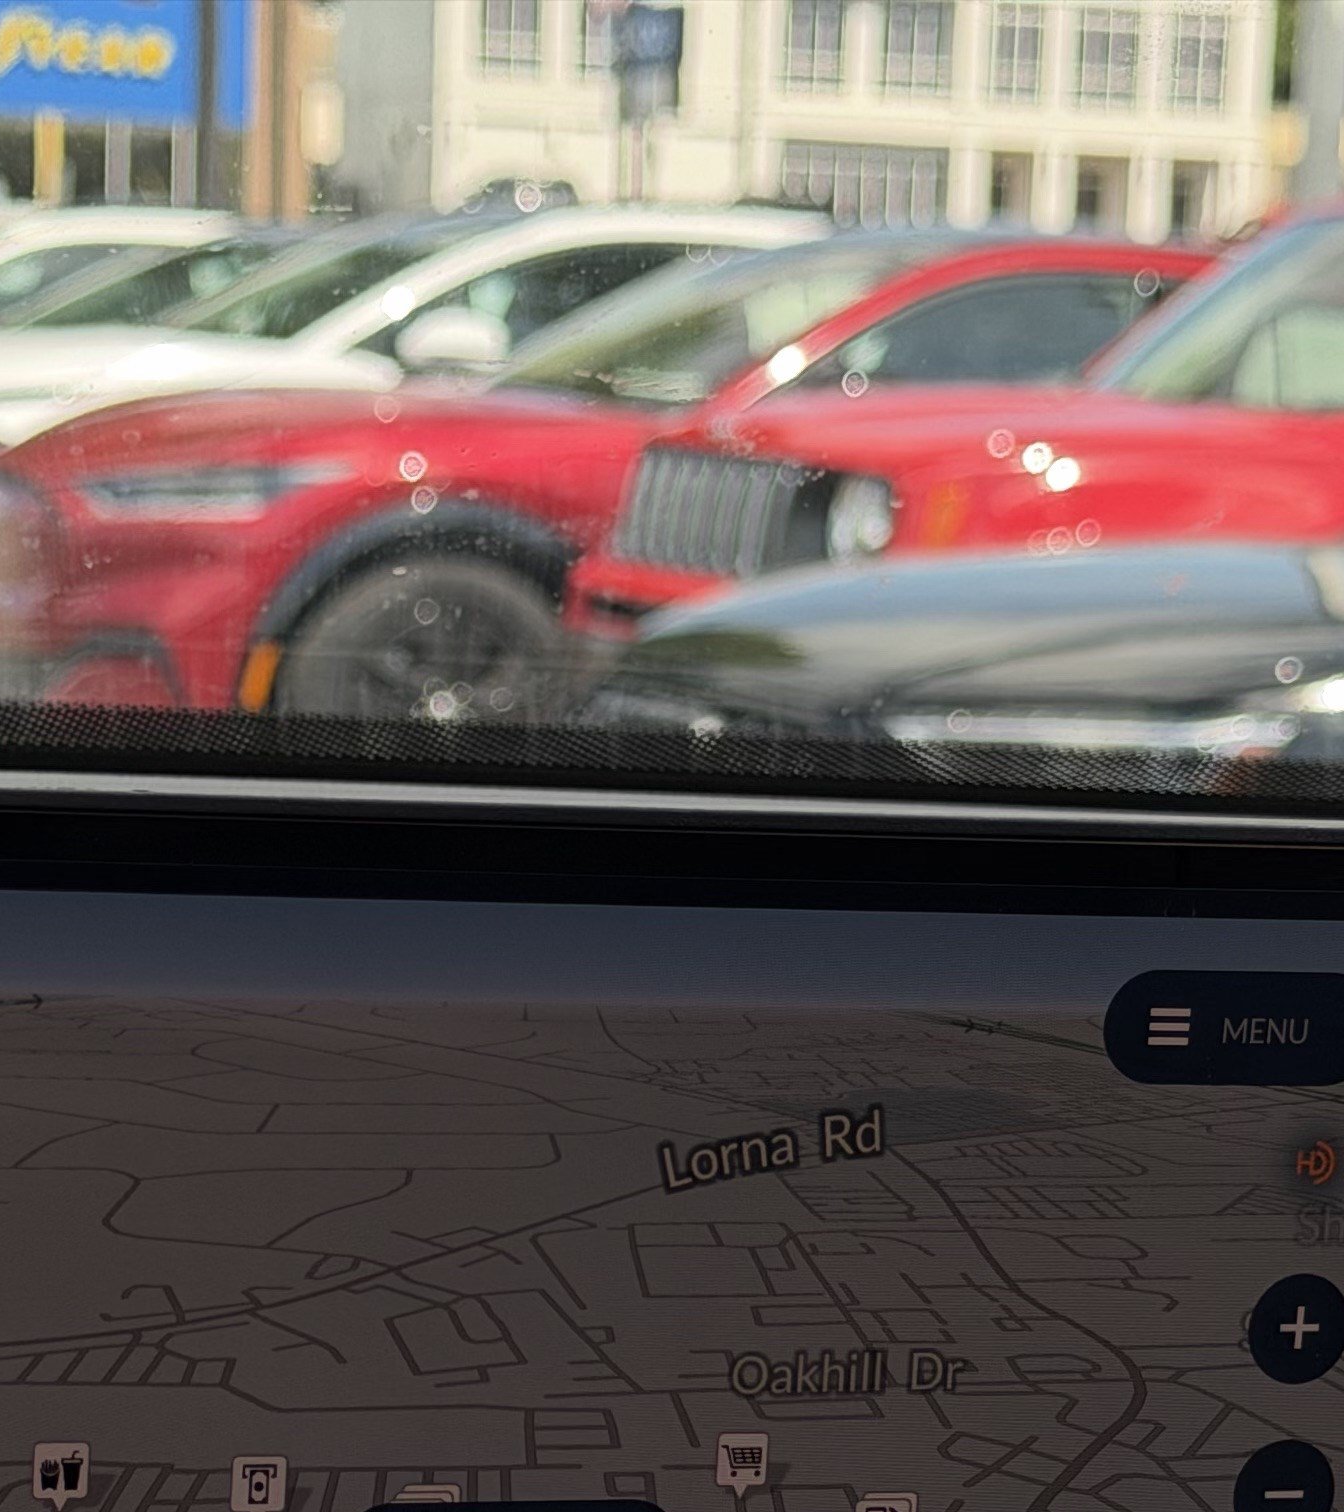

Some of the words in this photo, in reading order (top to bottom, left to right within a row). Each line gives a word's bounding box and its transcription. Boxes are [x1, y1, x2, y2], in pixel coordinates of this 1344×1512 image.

[1222, 1015, 1310, 1045] MENU
[662, 1131, 797, 1189] Lorna
[824, 1109, 882, 1158] Rd
[731, 1350, 885, 1396] Oakhill
[910, 1352, 967, 1392] Dr
